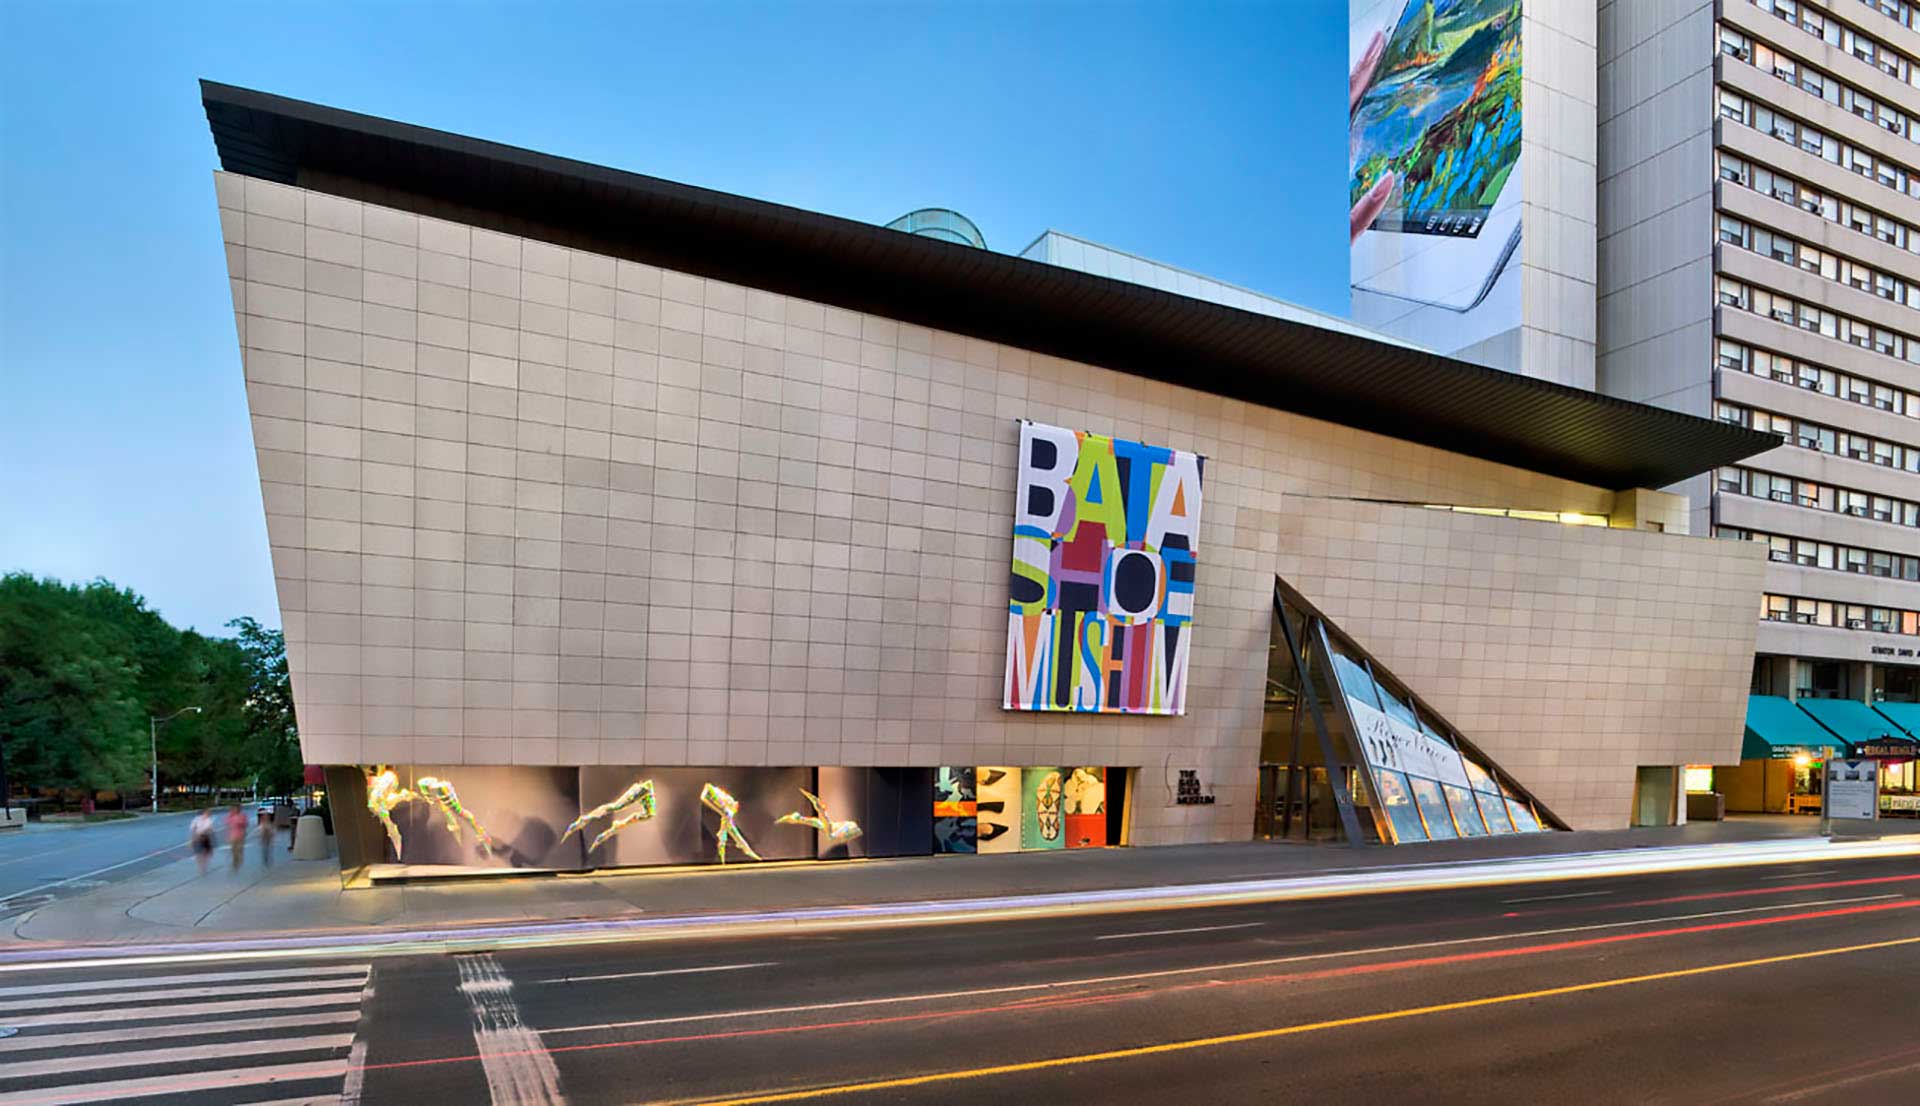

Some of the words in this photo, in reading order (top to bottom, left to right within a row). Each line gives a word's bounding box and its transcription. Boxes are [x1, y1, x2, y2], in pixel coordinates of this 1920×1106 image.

[1015, 421, 1203, 553] BATA
[1010, 526, 1197, 626] SHOE
[1004, 610, 1191, 716] MUSEUM
